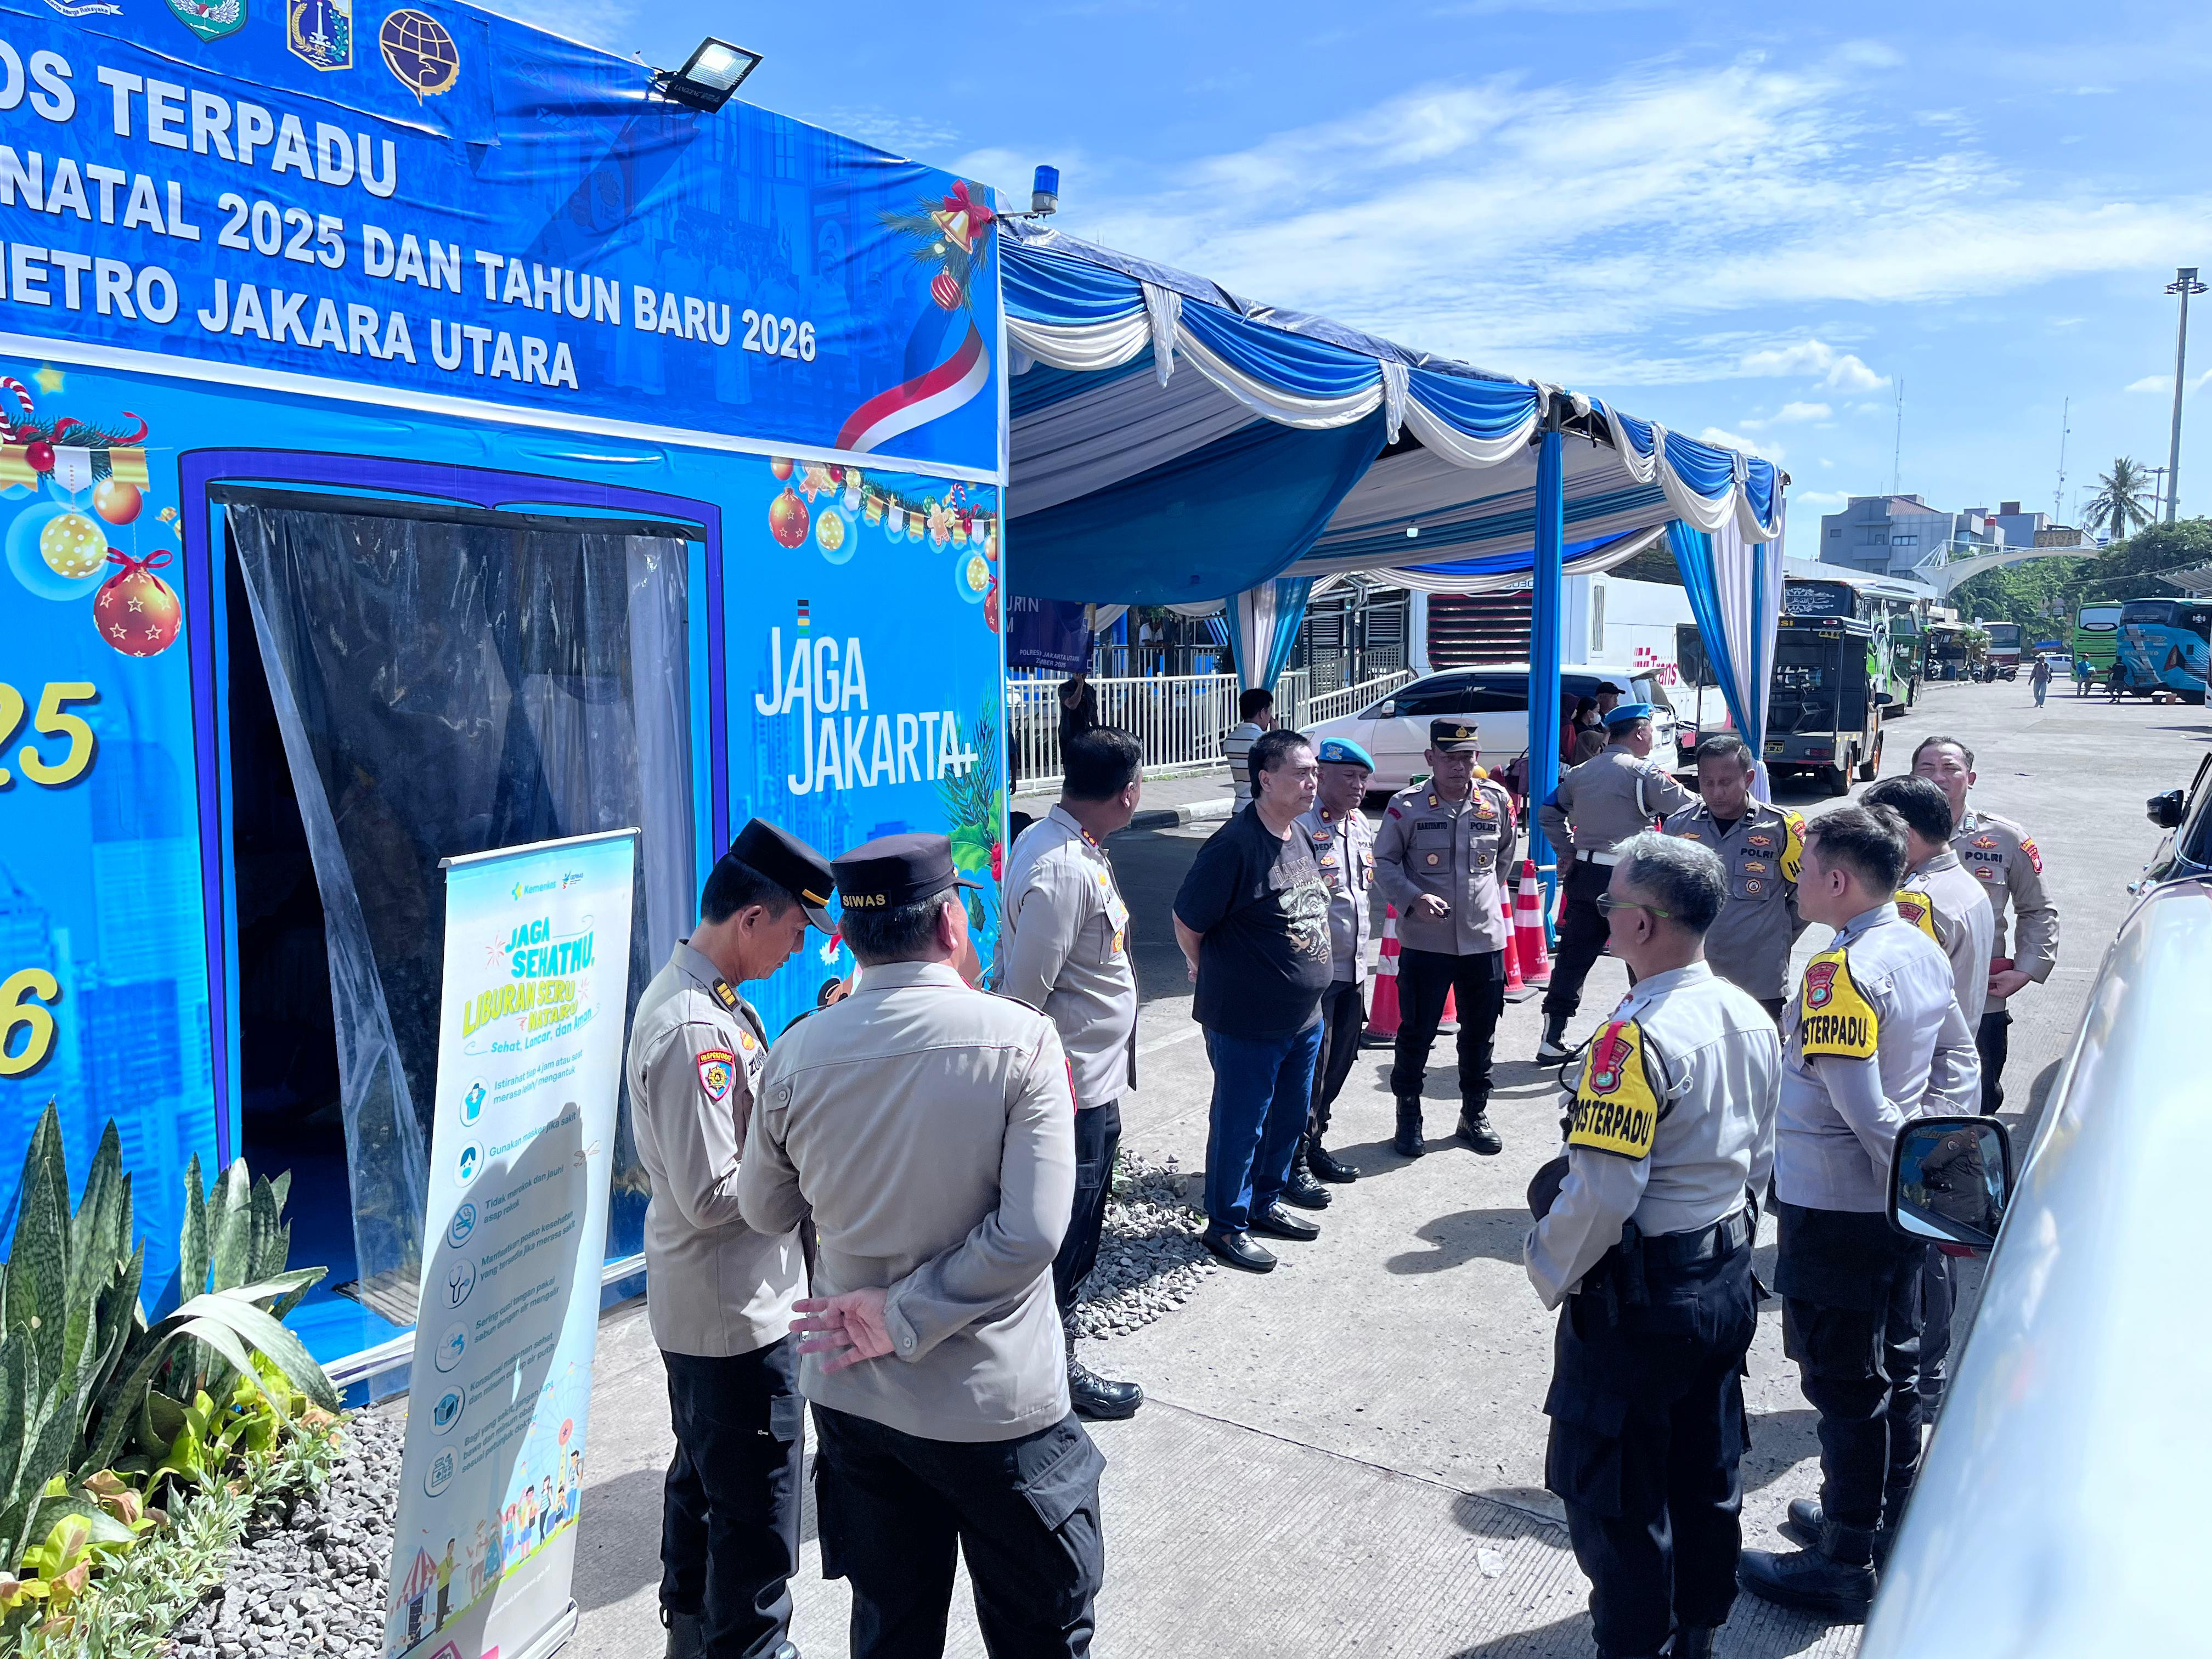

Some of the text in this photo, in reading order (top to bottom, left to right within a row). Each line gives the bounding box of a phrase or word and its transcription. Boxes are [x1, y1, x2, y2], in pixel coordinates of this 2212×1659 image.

[97, 65, 397, 198] TERPADU
[0, 145, 816, 363] NATAL 2025 DAN TAHUN BARU 2026
[0, 241, 579, 390] ETRO JAKARA UTARA
[755, 627, 868, 716] JAGA
[1042, 652, 1066, 661] JAKARTA
[1470, 822, 1497, 831] POLRI
[1740, 848, 1774, 859] POLRI
[1965, 851, 2002, 863] POLRI
[843, 894, 885, 907] SIWAS
[505, 917, 550, 953] JAGA
[462, 979, 575, 1039] LIBURAN SERU
[527, 999, 578, 1032] NATARU
[555, 1023, 572, 1037] dan
[574, 1008, 591, 1030] Aman
[493, 1089, 521, 1104] merasa
[538, 1065, 576, 1086] mengantuk
[495, 1073, 526, 1091] Istirahat
[541, 1060, 554, 1074] jam
[556, 1056, 571, 1067] atau
[489, 1111, 576, 1157] Gunakan masker jika sakit
[486, 1194, 506, 1210] Tidak
[533, 1173, 546, 1184] dan
[546, 1164, 564, 1181] jauhi
[484, 1210, 502, 1224] asap
[520, 1227, 540, 1246] posko
[541, 1210, 574, 1233] kesehatan
[480, 1265, 498, 1282] yang
[536, 1229, 562, 1247] merasa
[476, 1311, 499, 1330] Sering
[513, 1286, 536, 1306] tangan
[536, 1276, 556, 1294] pakai
[474, 1324, 496, 1344] sabun
[534, 1332, 554, 1349] sehat
[468, 1391, 483, 1406] dan
[464, 1428, 481, 1447] Bagi
[481, 1418, 497, 1436] yang
[516, 1390, 539, 1412] jangan
[463, 1442, 482, 1460] bawa
[482, 1431, 495, 1446] dan
